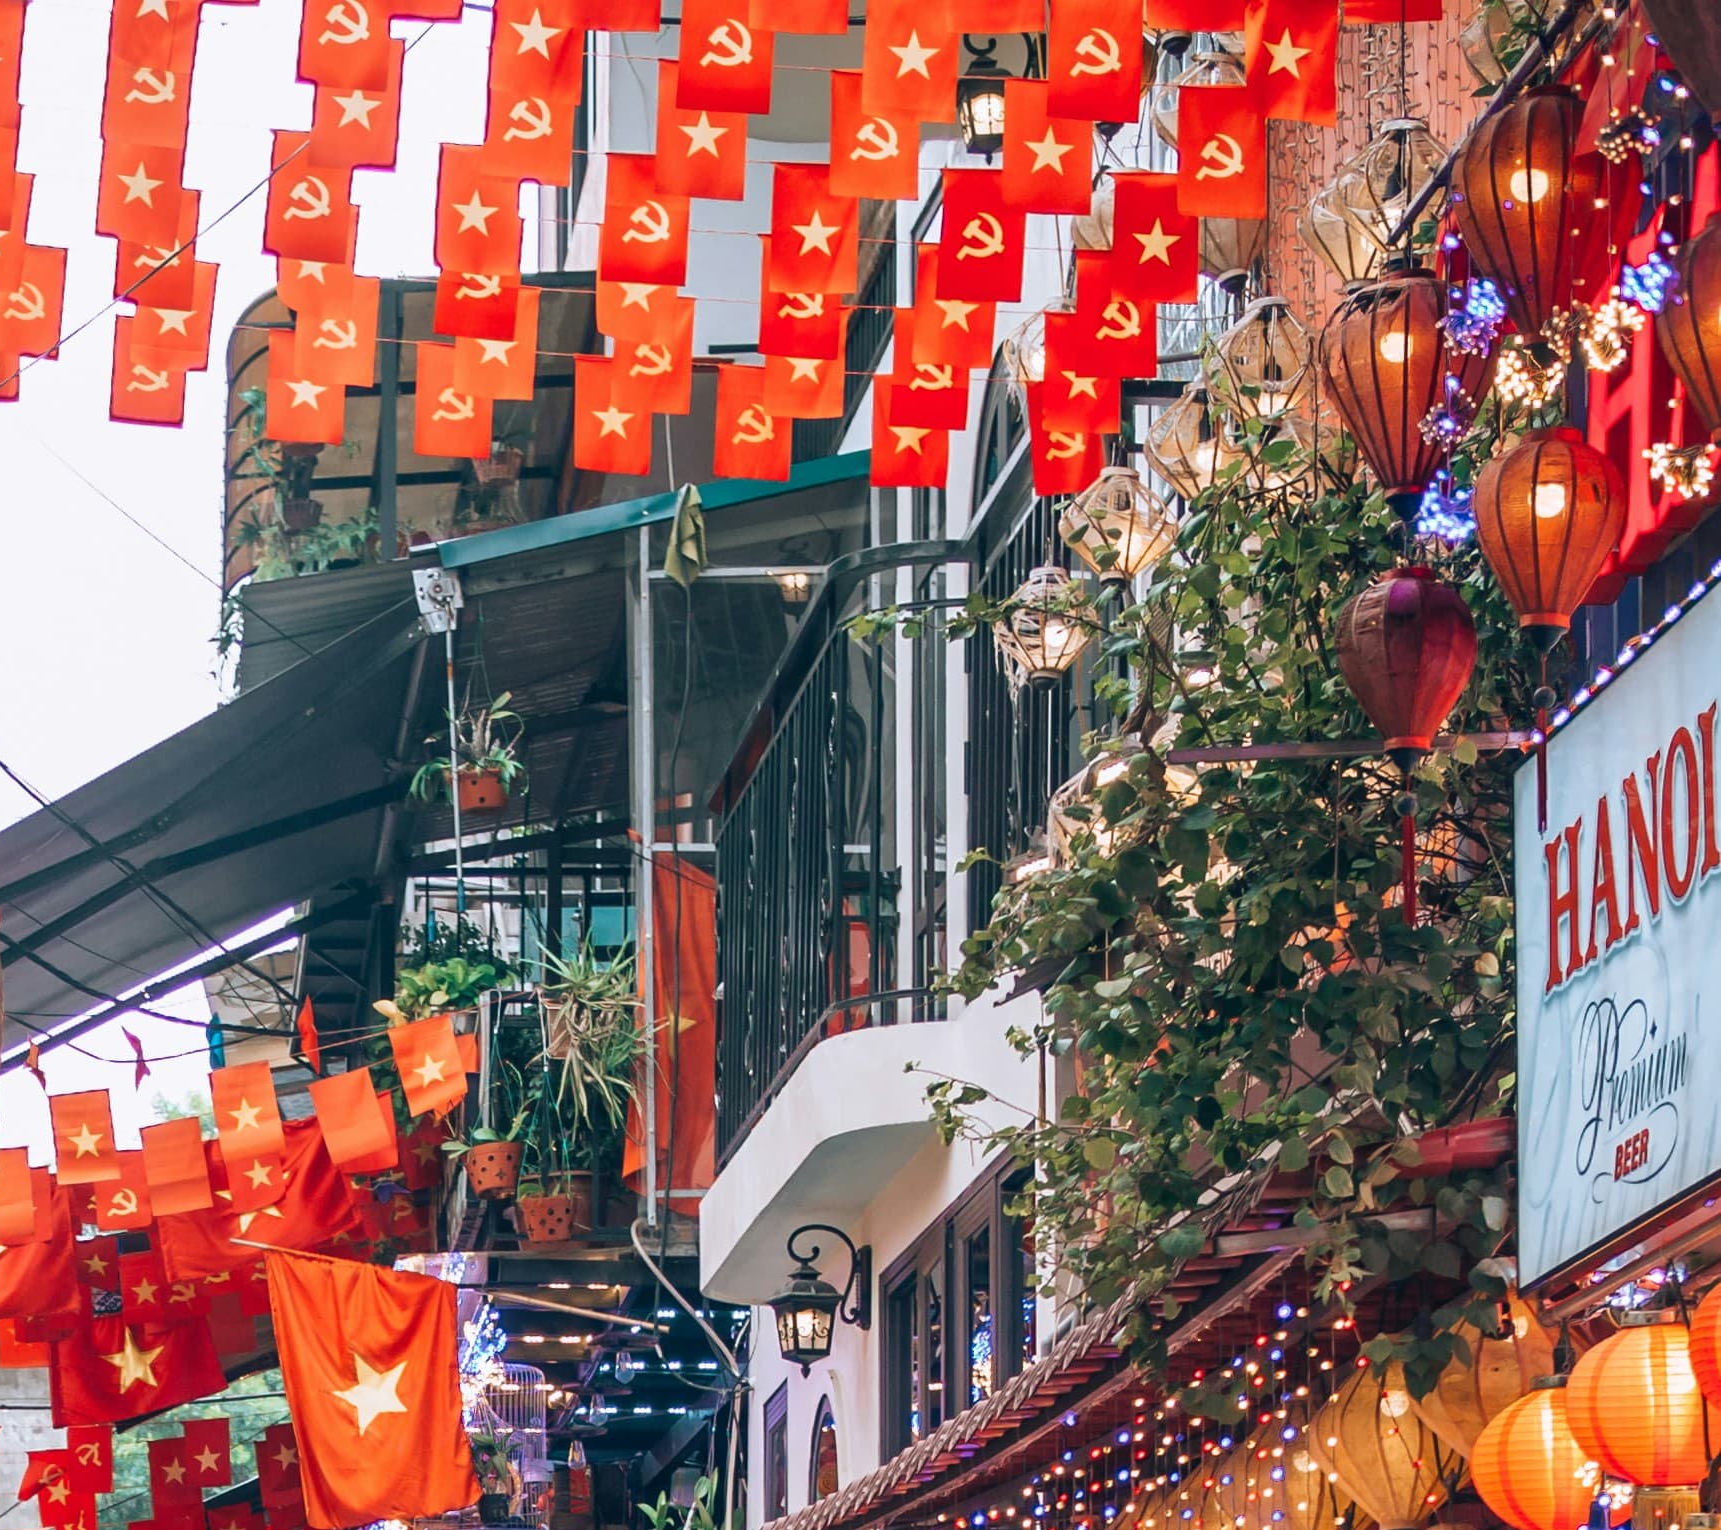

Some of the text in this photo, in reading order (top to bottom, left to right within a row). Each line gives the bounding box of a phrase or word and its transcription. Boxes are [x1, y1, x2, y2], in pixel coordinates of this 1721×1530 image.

[1545, 699, 1719, 993] HANOI
[1578, 998, 1689, 1175] Premium
[1613, 1128, 1650, 1182] BEER
